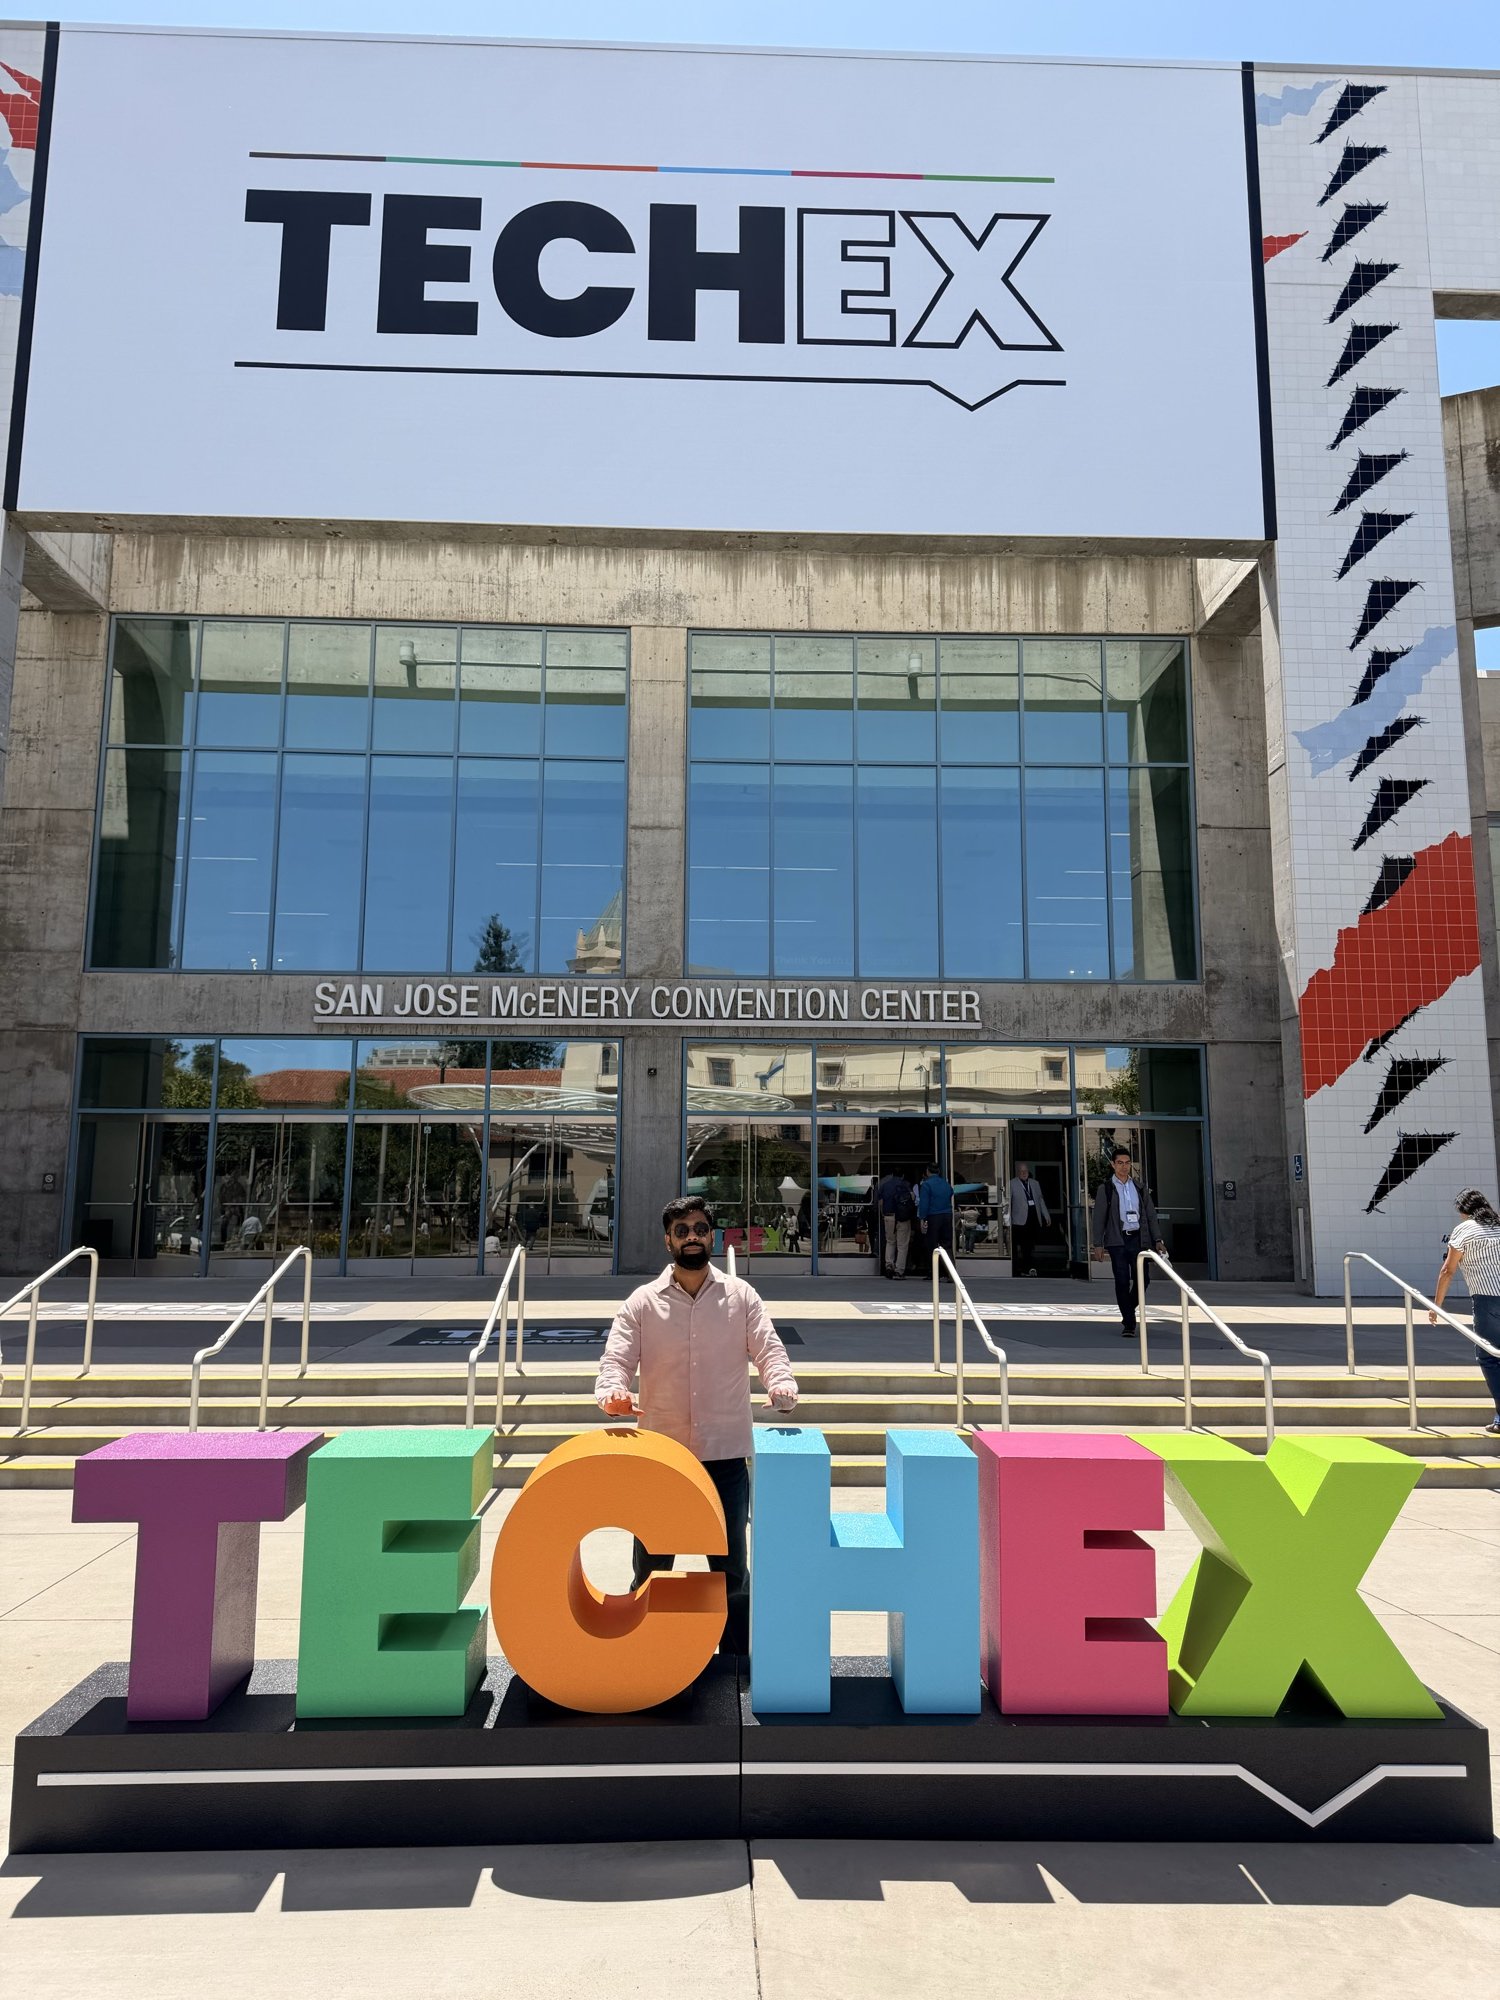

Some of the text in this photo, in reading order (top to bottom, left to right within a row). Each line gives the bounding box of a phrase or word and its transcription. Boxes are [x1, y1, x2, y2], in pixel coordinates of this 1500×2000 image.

[245, 189, 1065, 352] TECHEX
[313, 982, 982, 1022] SAN JOSE McENERY CONVENTION CENTER
[439, 1329, 610, 1338] TEC
[72, 1427, 1446, 1722] TECHEX
